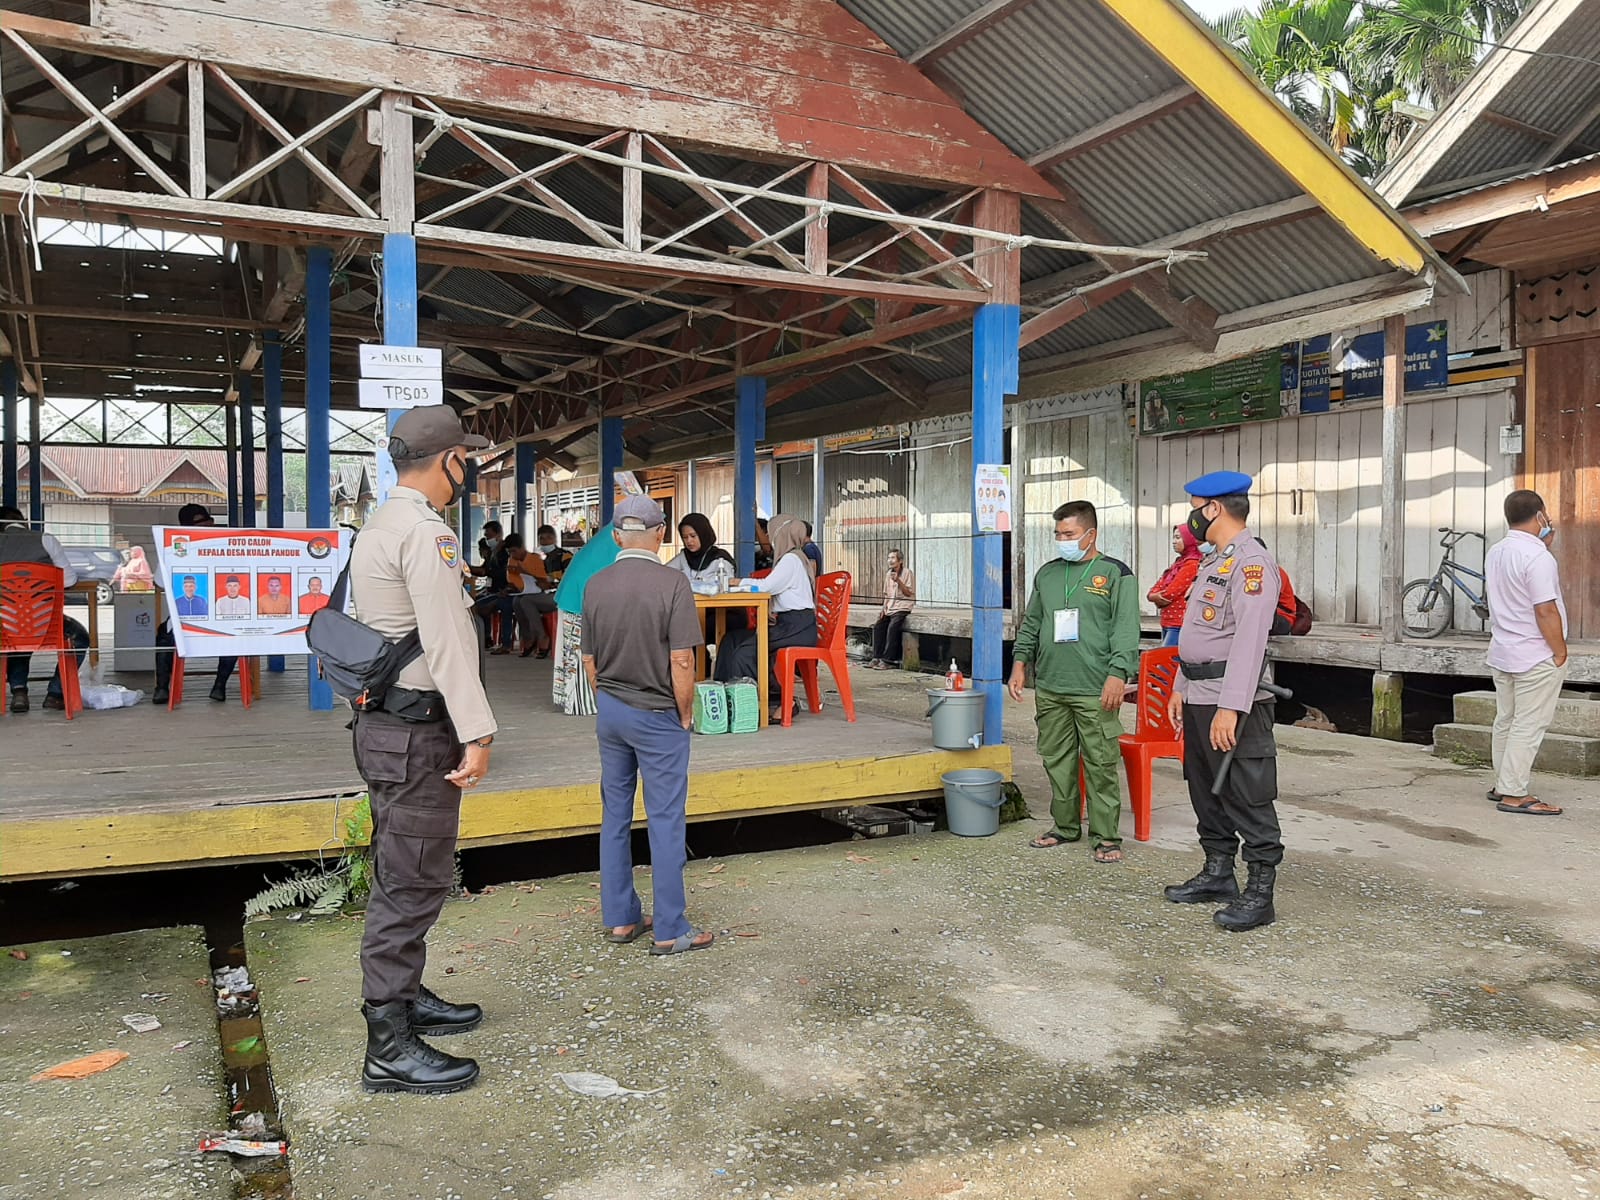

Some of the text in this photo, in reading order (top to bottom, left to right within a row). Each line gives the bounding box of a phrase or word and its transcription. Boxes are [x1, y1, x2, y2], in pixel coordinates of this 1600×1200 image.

[382, 353, 424, 364] MASUK
[1351, 367, 1377, 380] Paket
[1418, 361, 1431, 371] XL
[227, 538, 272, 547] FOTO CALON
[197, 548, 226, 557] KEPALA
[226, 548, 246, 557] DESA
[246, 548, 270, 557] KUALA
[1207, 576, 1227, 587] POLRI
